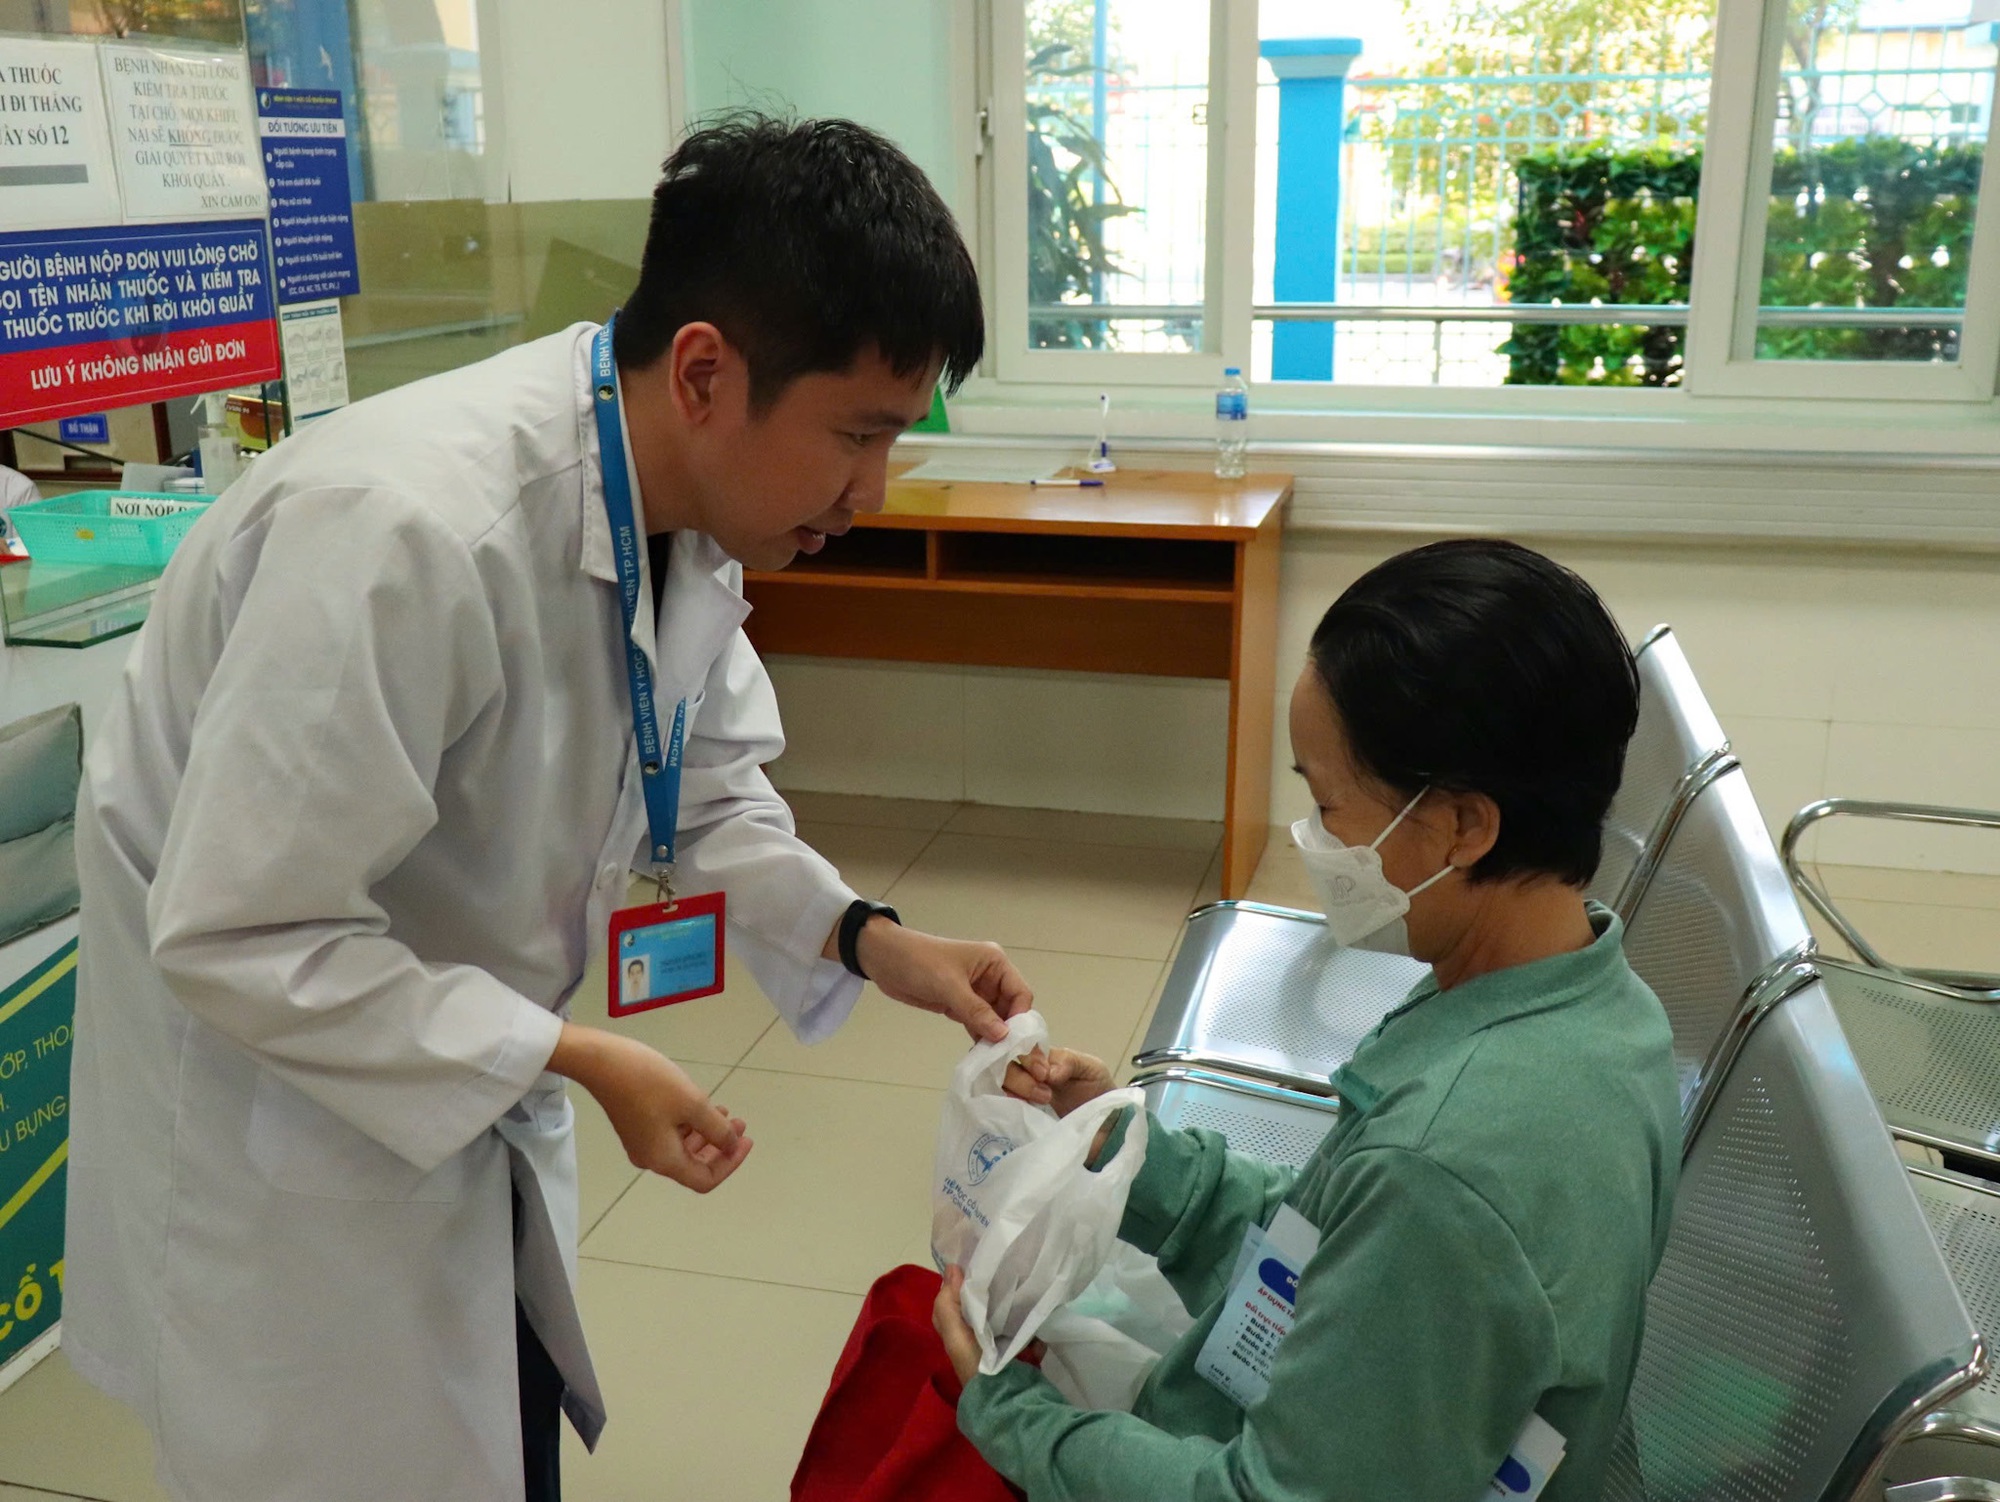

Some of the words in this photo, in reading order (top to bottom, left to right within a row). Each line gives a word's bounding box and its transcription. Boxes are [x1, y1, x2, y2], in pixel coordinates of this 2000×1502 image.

[8, 63, 62, 85] THUỐC
[10, 95, 26, 112] ĐI
[0, 124, 22, 146] ẦY
[27, 123, 48, 146] SỐ
[51, 125, 70, 145] 12
[201, 194, 219, 209] XIN
[44, 251, 87, 282] BỆNH
[89, 248, 124, 278] NỘP
[126, 248, 160, 271] ĐƠN
[162, 248, 190, 268] VUI
[188, 242, 227, 265] LÒNG
[228, 239, 259, 262] CHỜ
[0, 290, 22, 316] ỌI
[28, 281, 59, 308] TÊN
[65, 276, 113, 307] NHẬN
[118, 269, 170, 299] THUỐC
[175, 269, 197, 294] VÀ
[201, 263, 234, 291] KIỂM
[237, 268, 262, 287] TRA
[3, 307, 64, 340] THUỐC
[66, 303, 121, 333] TRƯỚC
[124, 304, 150, 326] KHI
[153, 298, 179, 322] RỜI
[181, 292, 216, 319] KHỎI
[31, 365, 62, 391] LƯU
[65, 358, 76, 385] Ý
[81, 353, 140, 383] KHÔNG
[142, 346, 186, 375] NHẬN
[187, 339, 213, 367] GỬI
[215, 339, 247, 363] ĐƠN
[114, 502, 141, 516] NƠI
[16, 1095, 67, 1142] BỤNG
